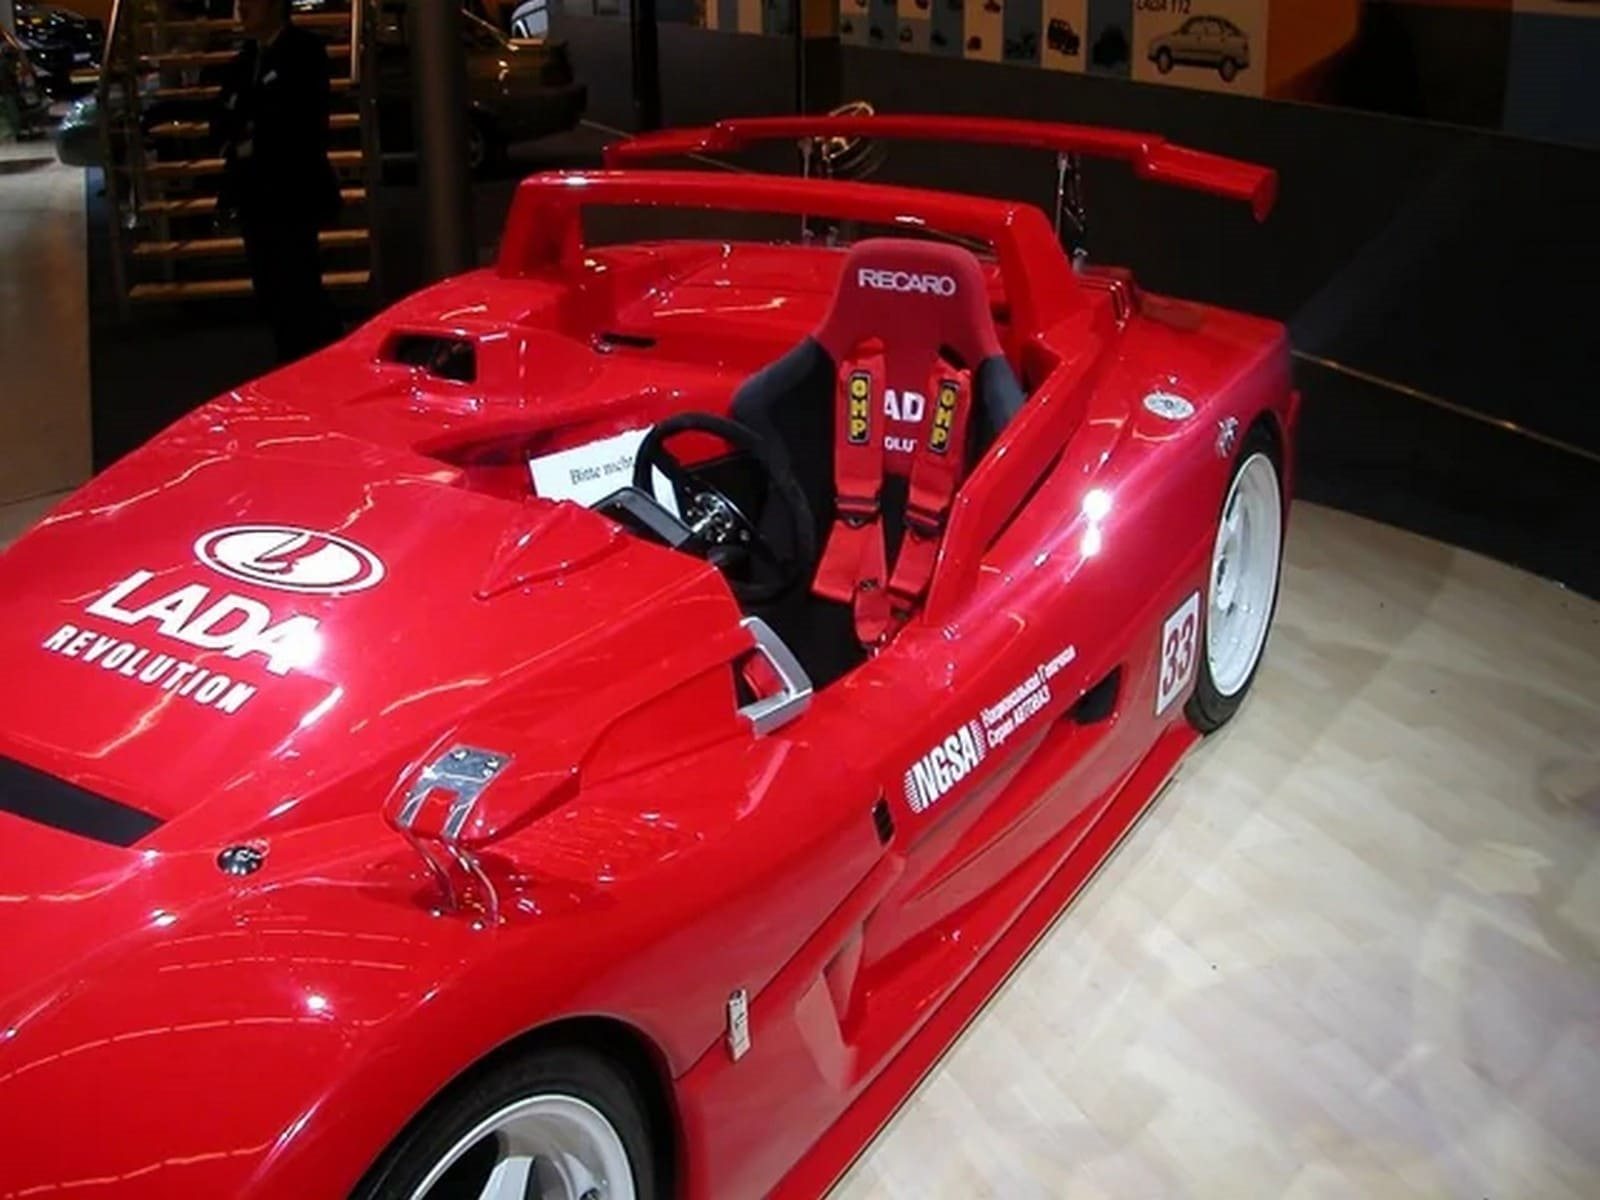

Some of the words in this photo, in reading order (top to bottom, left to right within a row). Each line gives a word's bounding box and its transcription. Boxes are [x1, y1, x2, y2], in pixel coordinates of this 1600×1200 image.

[858, 268, 957, 296] RECARO
[884, 389, 926, 422] AD
[84, 569, 321, 676] LADA
[1162, 612, 1195, 697] 33
[42, 623, 257, 714] REVOLUTION
[911, 724, 980, 809] NGSA
